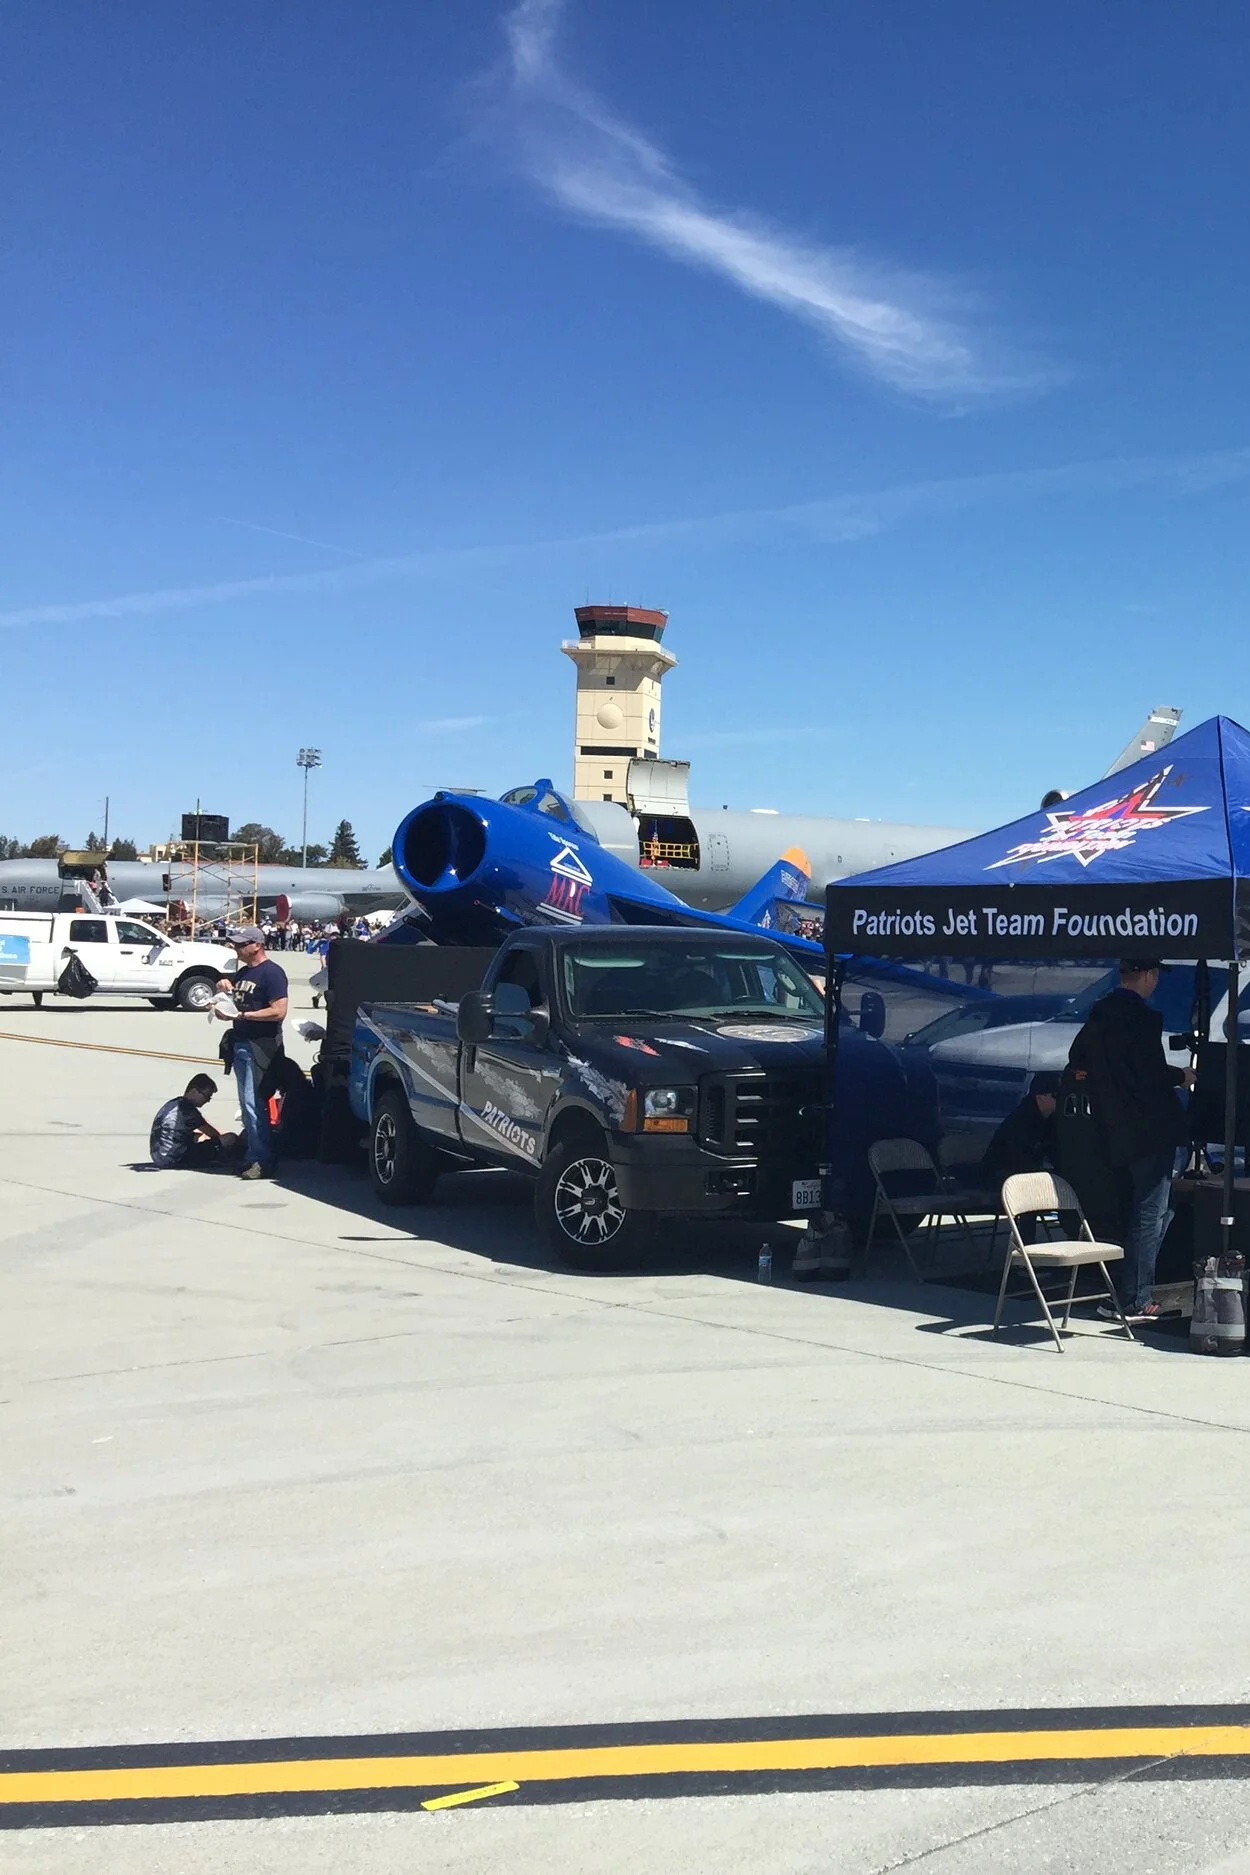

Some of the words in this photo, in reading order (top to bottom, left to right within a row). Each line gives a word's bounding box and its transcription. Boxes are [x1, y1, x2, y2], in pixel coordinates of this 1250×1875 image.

[12, 885, 27, 894] AIR
[30, 885, 60, 895] FORCE
[852, 908, 936, 936] Patriots
[942, 908, 978, 936] Jet
[982, 907, 1045, 936] Team
[1051, 906, 1198, 937] Foundation
[480, 1100, 536, 1155] PATRIOTS
